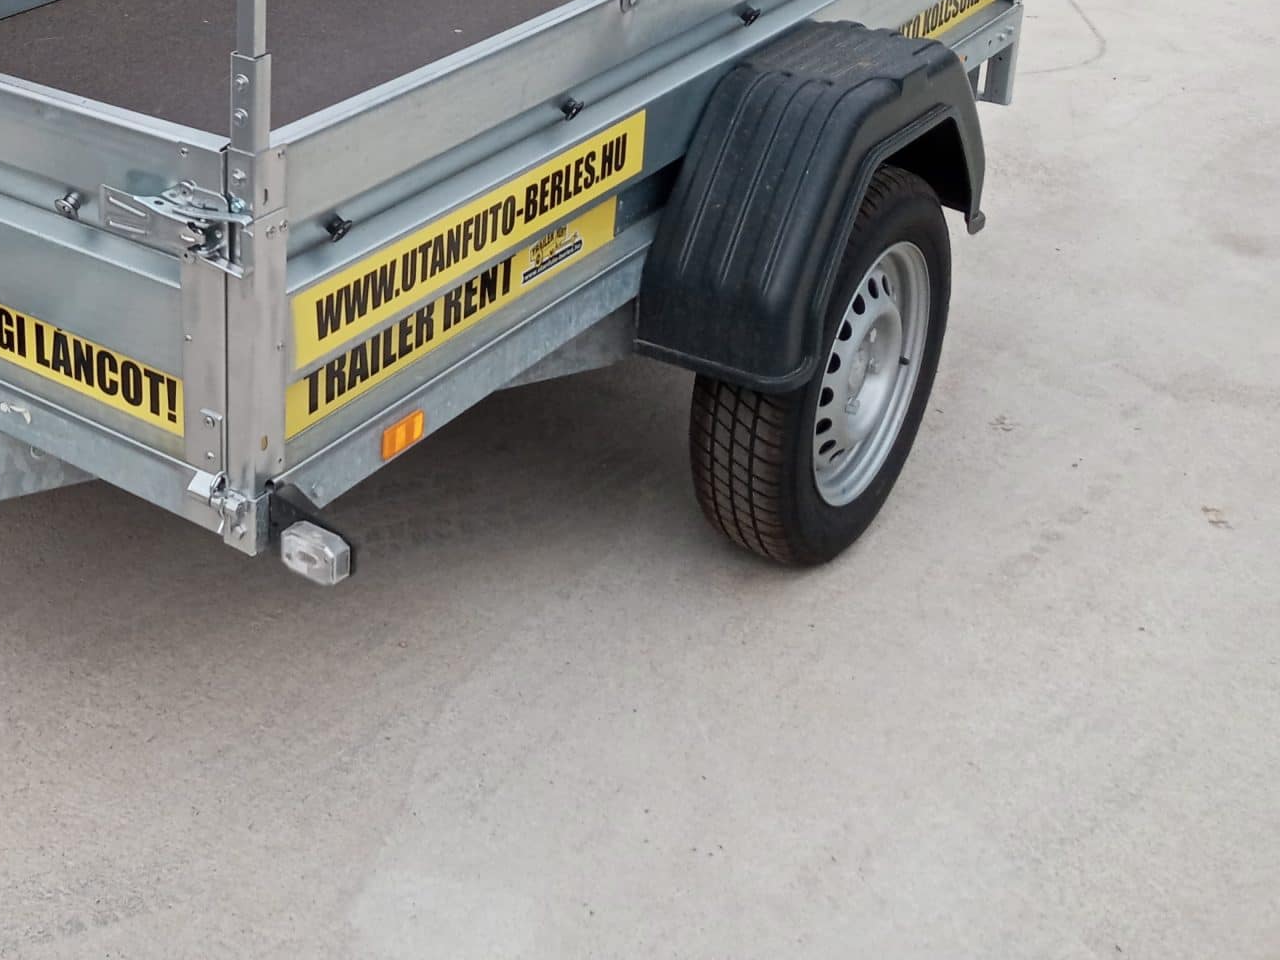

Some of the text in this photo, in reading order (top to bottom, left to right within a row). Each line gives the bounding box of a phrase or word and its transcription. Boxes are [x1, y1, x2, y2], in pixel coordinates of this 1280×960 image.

[315, 132, 629, 342] WWW.UTANFUTO-BERLES.HU
[33, 323, 178, 423] LÁNCOT!
[303, 300, 437, 415] TRAILER
[442, 254, 517, 333] RENT
